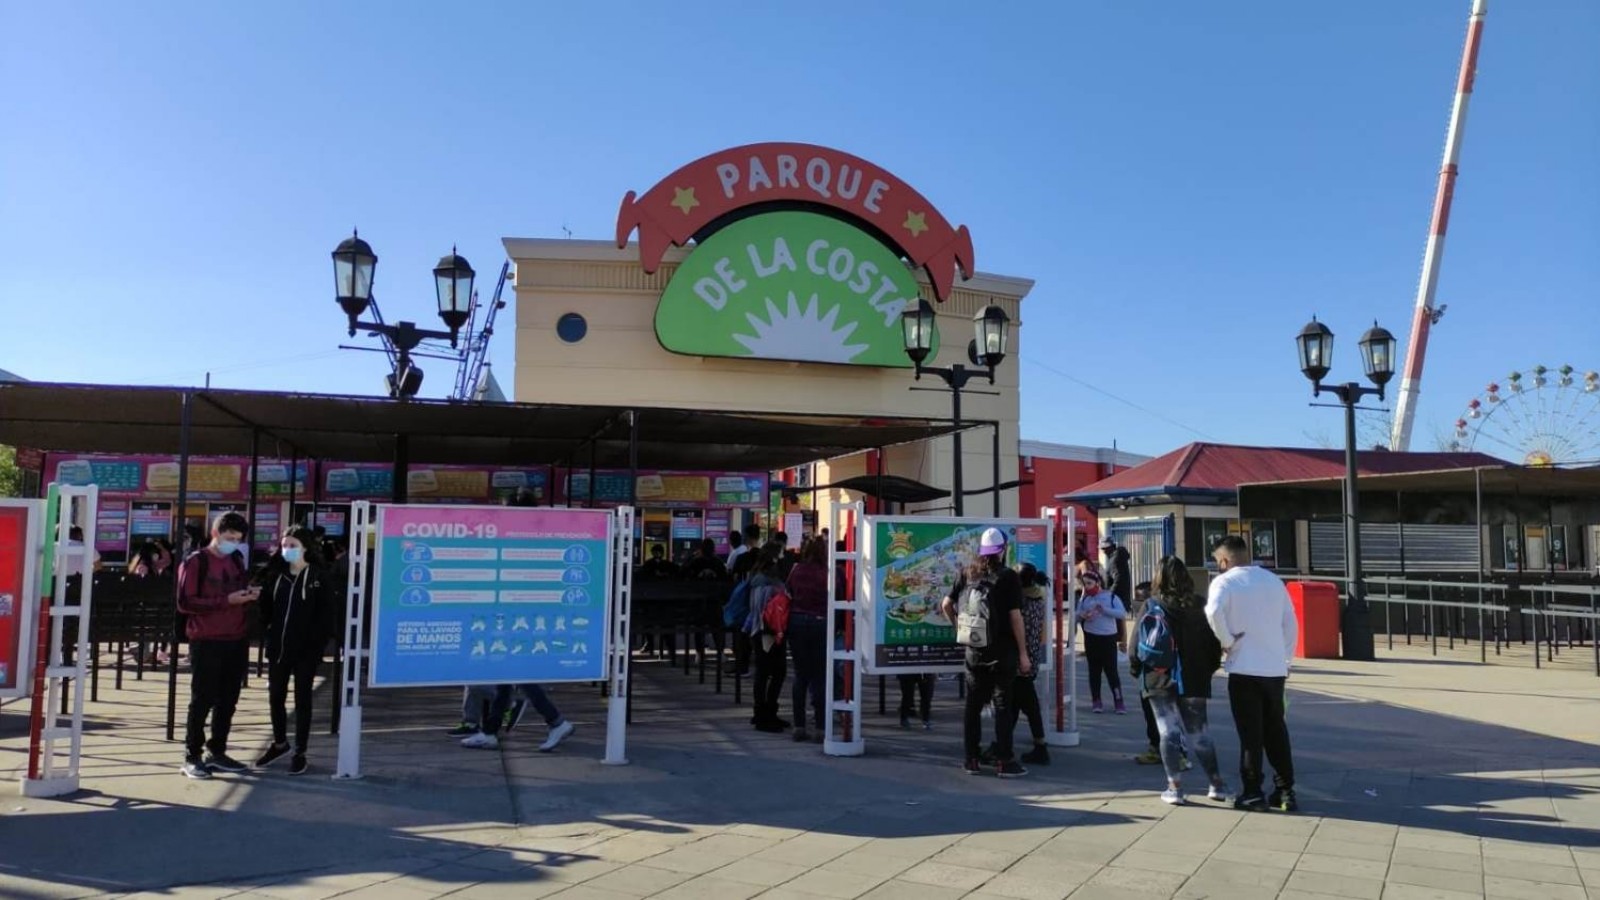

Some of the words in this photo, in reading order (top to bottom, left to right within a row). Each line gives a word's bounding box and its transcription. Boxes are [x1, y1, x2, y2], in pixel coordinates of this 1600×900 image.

[716, 154, 891, 214] PARQUE
[693, 256, 747, 312] DE
[746, 236, 797, 278] LA
[806, 239, 909, 328] COSTA
[402, 522, 497, 539] COVID-19
[396, 634, 414, 644] DE
[416, 633, 462, 643] MANOS
